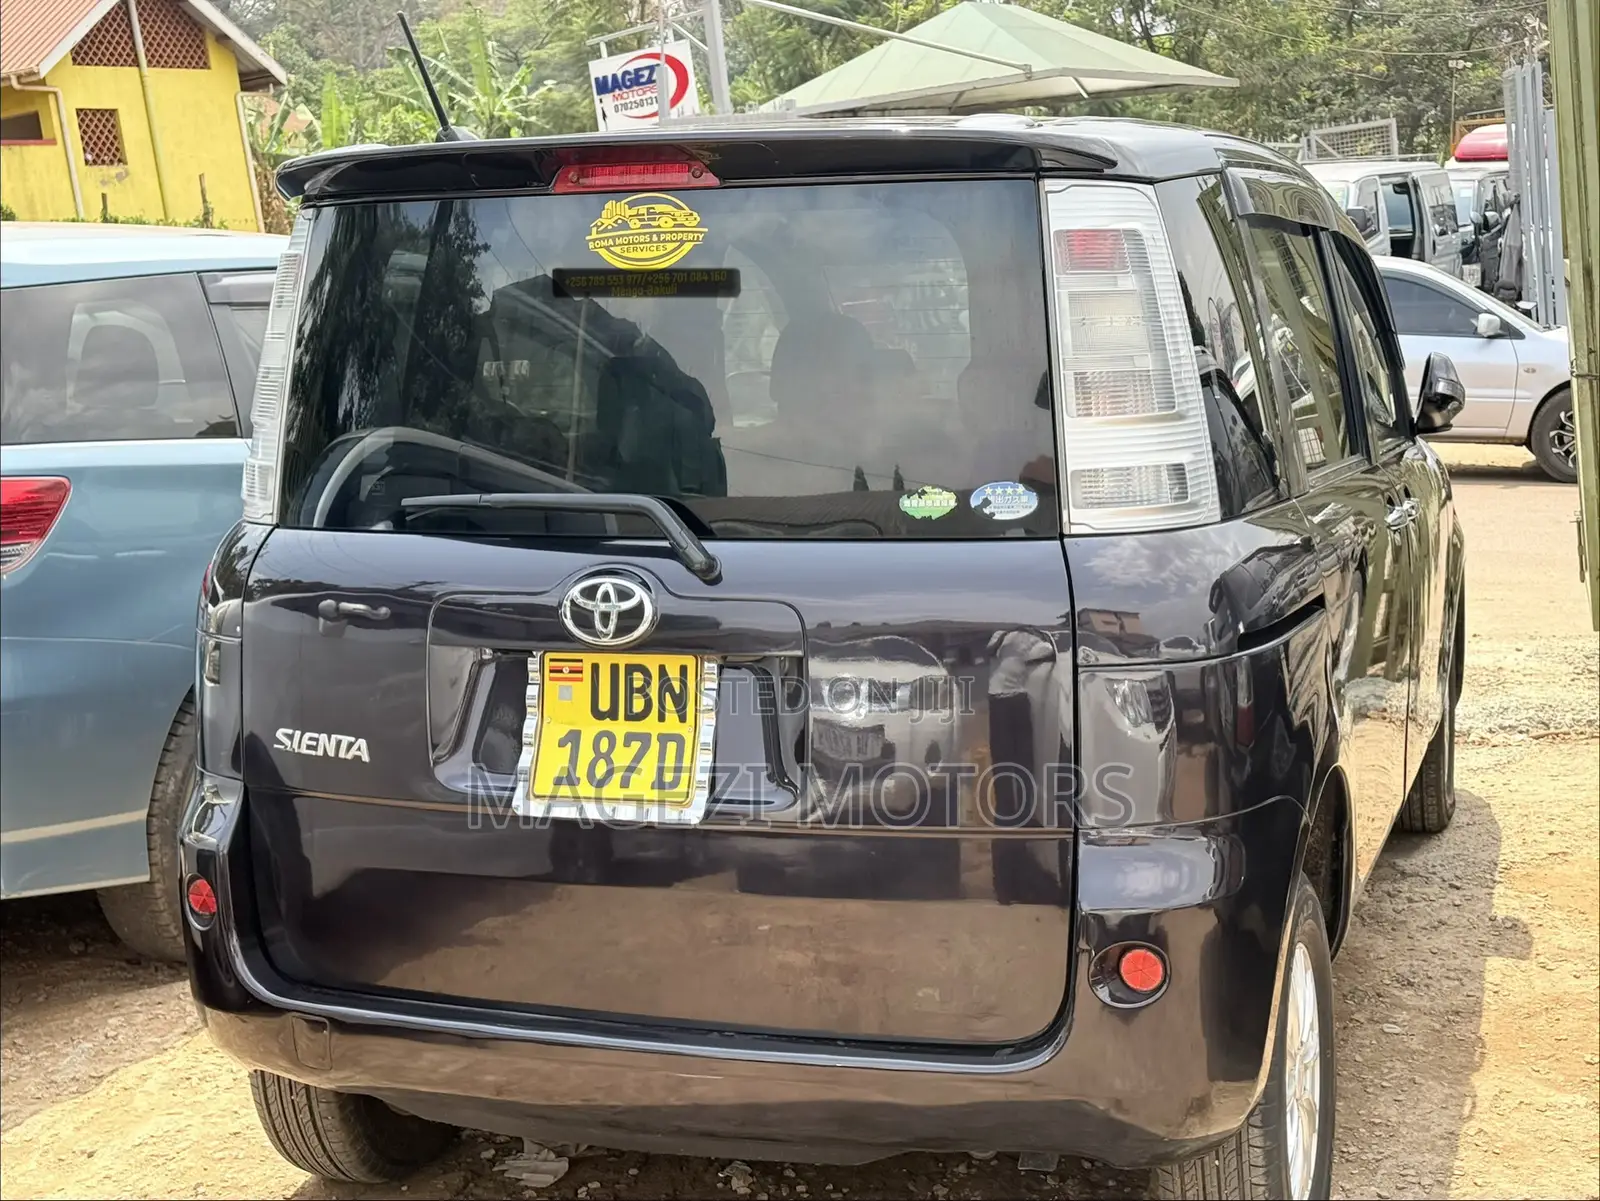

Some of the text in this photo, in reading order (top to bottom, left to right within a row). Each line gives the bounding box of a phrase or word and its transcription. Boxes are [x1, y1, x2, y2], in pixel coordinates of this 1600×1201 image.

[594, 63, 660, 96] MAGEZ
[613, 95, 659, 113] 070250131
[588, 232, 705, 250] ROMA MOTORS & PROPERTY
[620, 244, 668, 254] SERVICES
[590, 663, 688, 723] UBN
[273, 727, 370, 763] SIENTA
[553, 729, 686, 790] 187D
